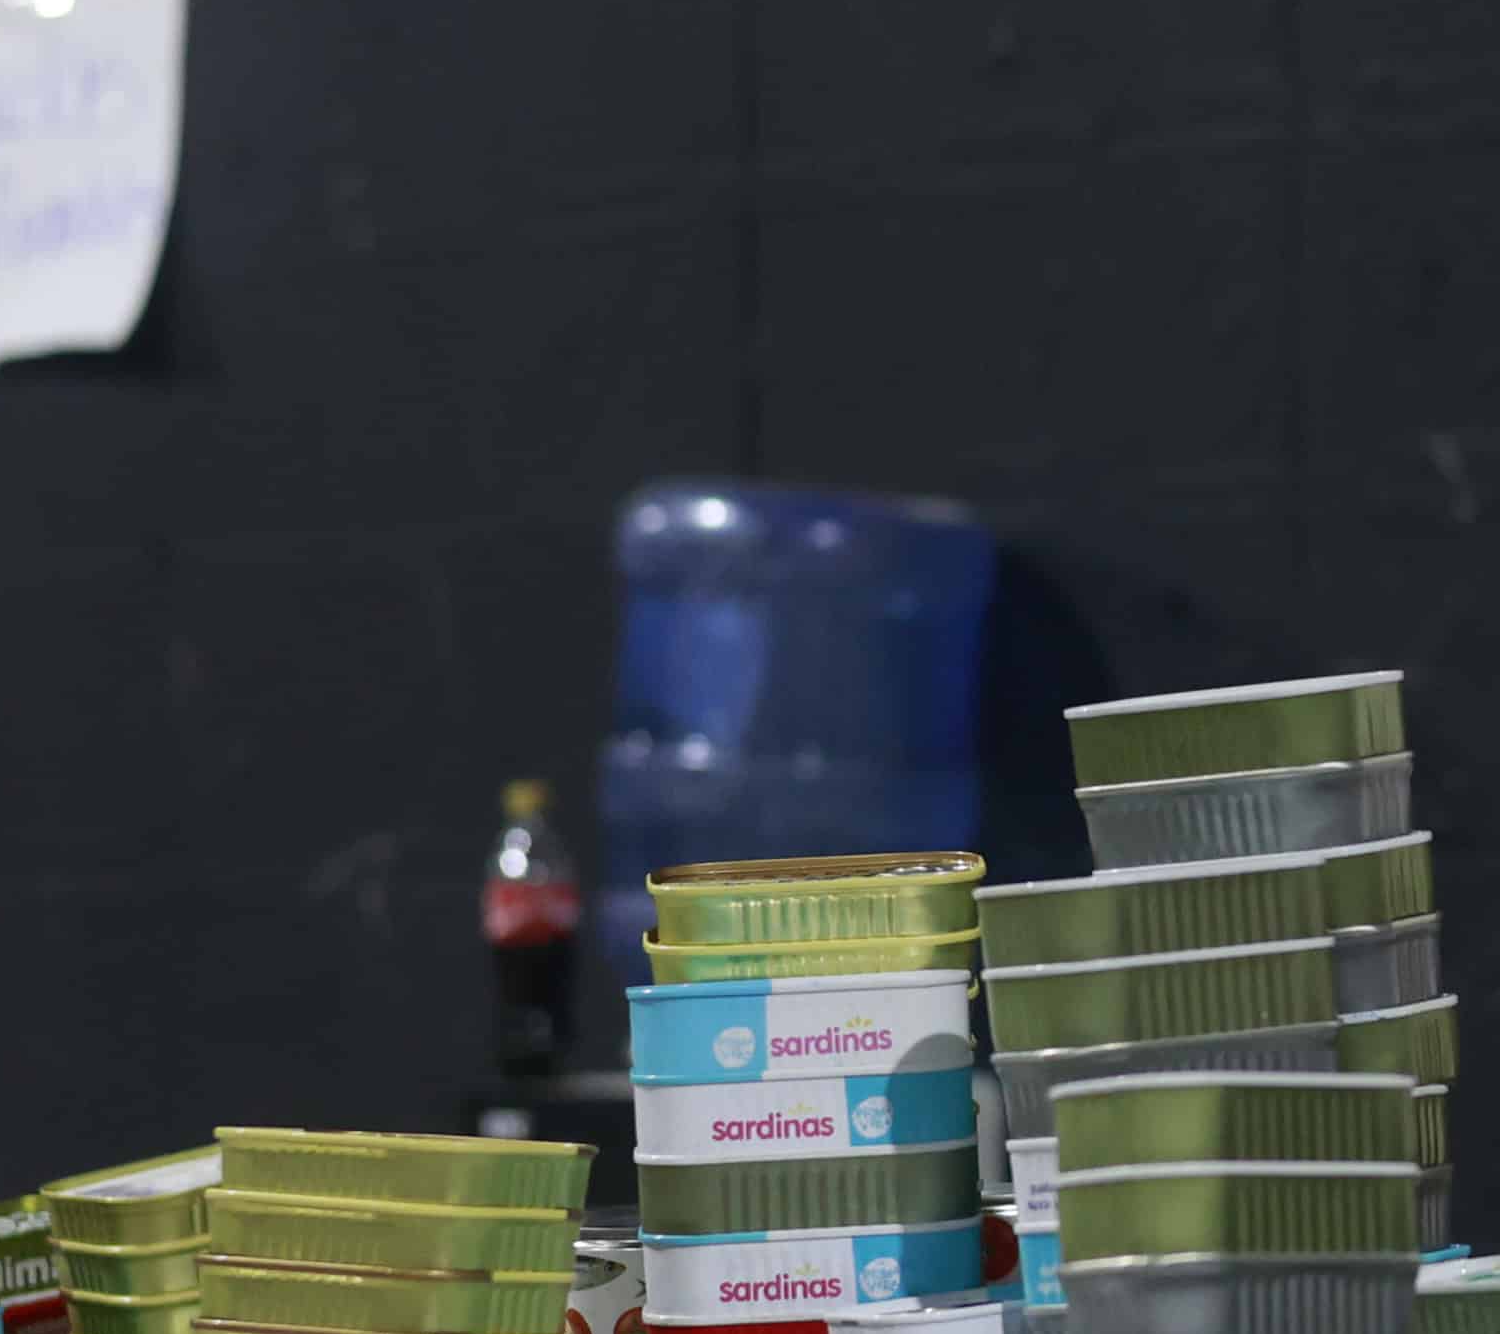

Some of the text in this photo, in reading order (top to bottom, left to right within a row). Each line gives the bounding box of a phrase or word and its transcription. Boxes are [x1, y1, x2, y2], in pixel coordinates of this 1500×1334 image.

[770, 1027, 893, 1058] sardinas
[711, 1111, 835, 1142] sardinas
[719, 1272, 843, 1304] sardinas
